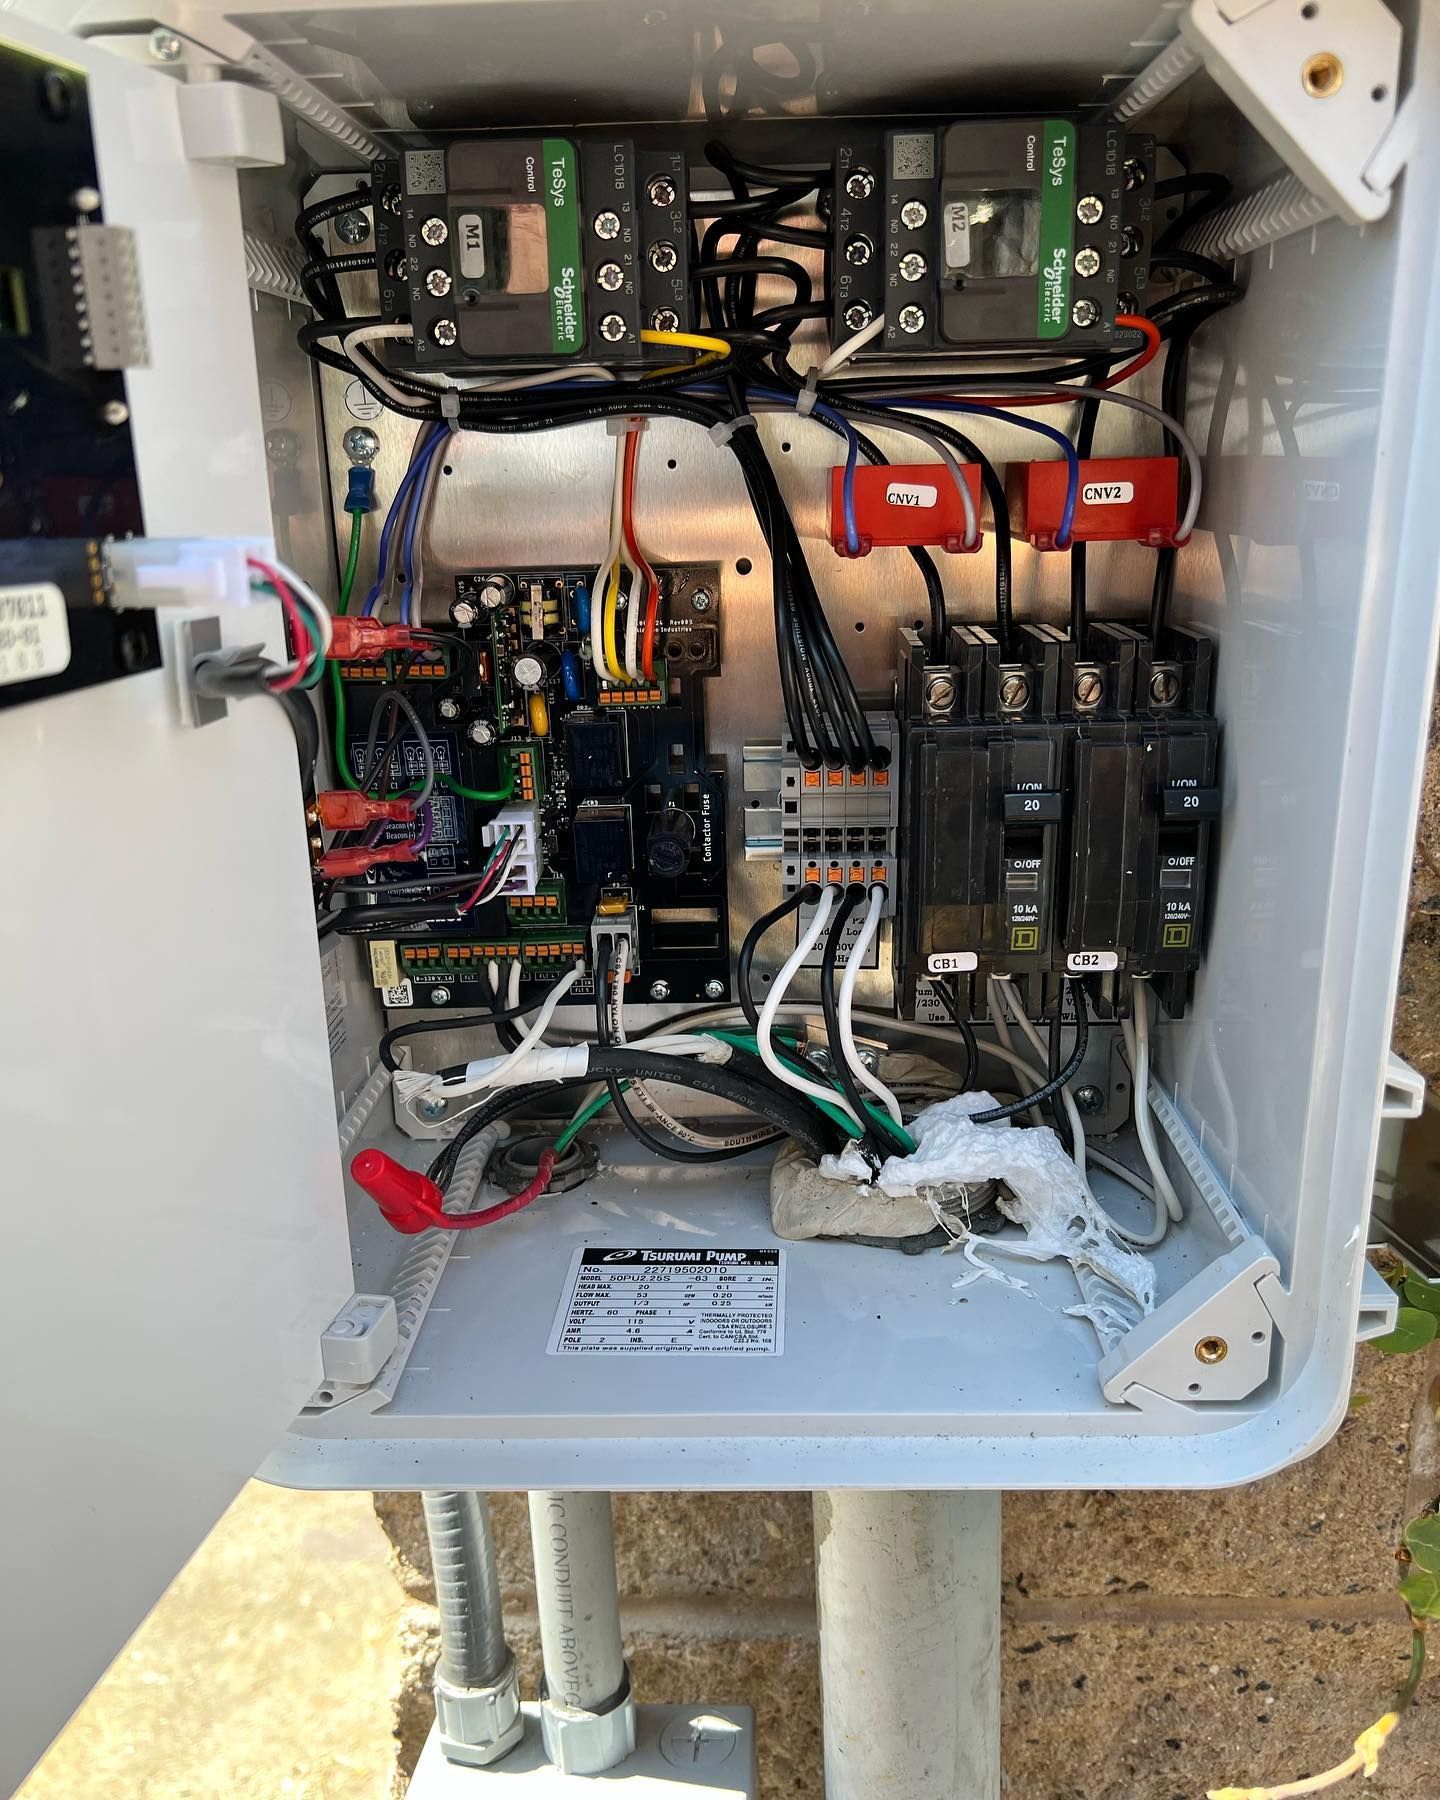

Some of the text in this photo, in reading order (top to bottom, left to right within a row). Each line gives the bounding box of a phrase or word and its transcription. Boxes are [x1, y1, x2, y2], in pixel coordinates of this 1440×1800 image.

[839, 147, 853, 169] 2T1
[1027, 135, 1036, 172] Control
[1105, 130, 1117, 176] LC1D18
[613, 144, 625, 190] LC1D18
[669, 153, 681, 172] 1L1
[1052, 136, 1066, 186] TeSys
[525, 157, 535, 193] Control
[552, 157, 566, 207] TeSys
[889, 194, 899, 205] 14
[1110, 189, 1120, 201] 13
[405, 209, 414, 220] 14
[622, 201, 631, 213] 13
[670, 211, 682, 234] 3L2
[840, 207, 853, 232] 4T2
[890, 220, 899, 234] NO
[951, 206, 966, 233] M2
[1109, 215, 1118, 230] NO
[408, 234, 417, 249] NO
[465, 223, 479, 251] M1
[623, 228, 632, 243] NO
[889, 242, 899, 257] 22
[1108, 242, 1117, 255] 21
[409, 257, 418, 272] 22
[623, 253, 633, 266] 21
[888, 273, 898, 288] NC
[1105, 269, 1115, 284] NC
[624, 280, 634, 295] NC
[671, 278, 684, 302] 5L3
[839, 276, 853, 299] 6T3
[1052, 248, 1066, 324] Schneider
[412, 287, 421, 302] NC
[561, 267, 575, 343] Schneider
[1043, 282, 1052, 324] Electric
[554, 299, 564, 341] Electric
[887, 325, 896, 340] A2
[1102, 321, 1111, 335] A1
[417, 339, 426, 353] A2
[627, 332, 636, 345] A1
[887, 492, 921, 506] CNV1
[1084, 486, 1121, 501] CNV2
[1024, 800, 1040, 812] 20
[1183, 796, 1199, 808] 20
[702, 793, 712, 862] Contactor Fuse
[386, 832, 408, 840] Beacon
[1013, 904, 1038, 914] 10 kA
[1166, 902, 1191, 911] 10 kA
[933, 959, 959, 969] CB1
[1072, 955, 1099, 966] CB2
[611, 1000, 620, 1034] NYLON
[635, 1069, 681, 1082] UNITED
[693, 1079, 715, 1091] CSA
[723, 1127, 772, 1147] SOUTHWIRE
[641, 1250, 701, 1261] TSURUMI
[706, 1250, 747, 1262] PUMP
[644, 1266, 727, 1274] 22719502010
[549, 1522, 575, 1619] CONDUIT
